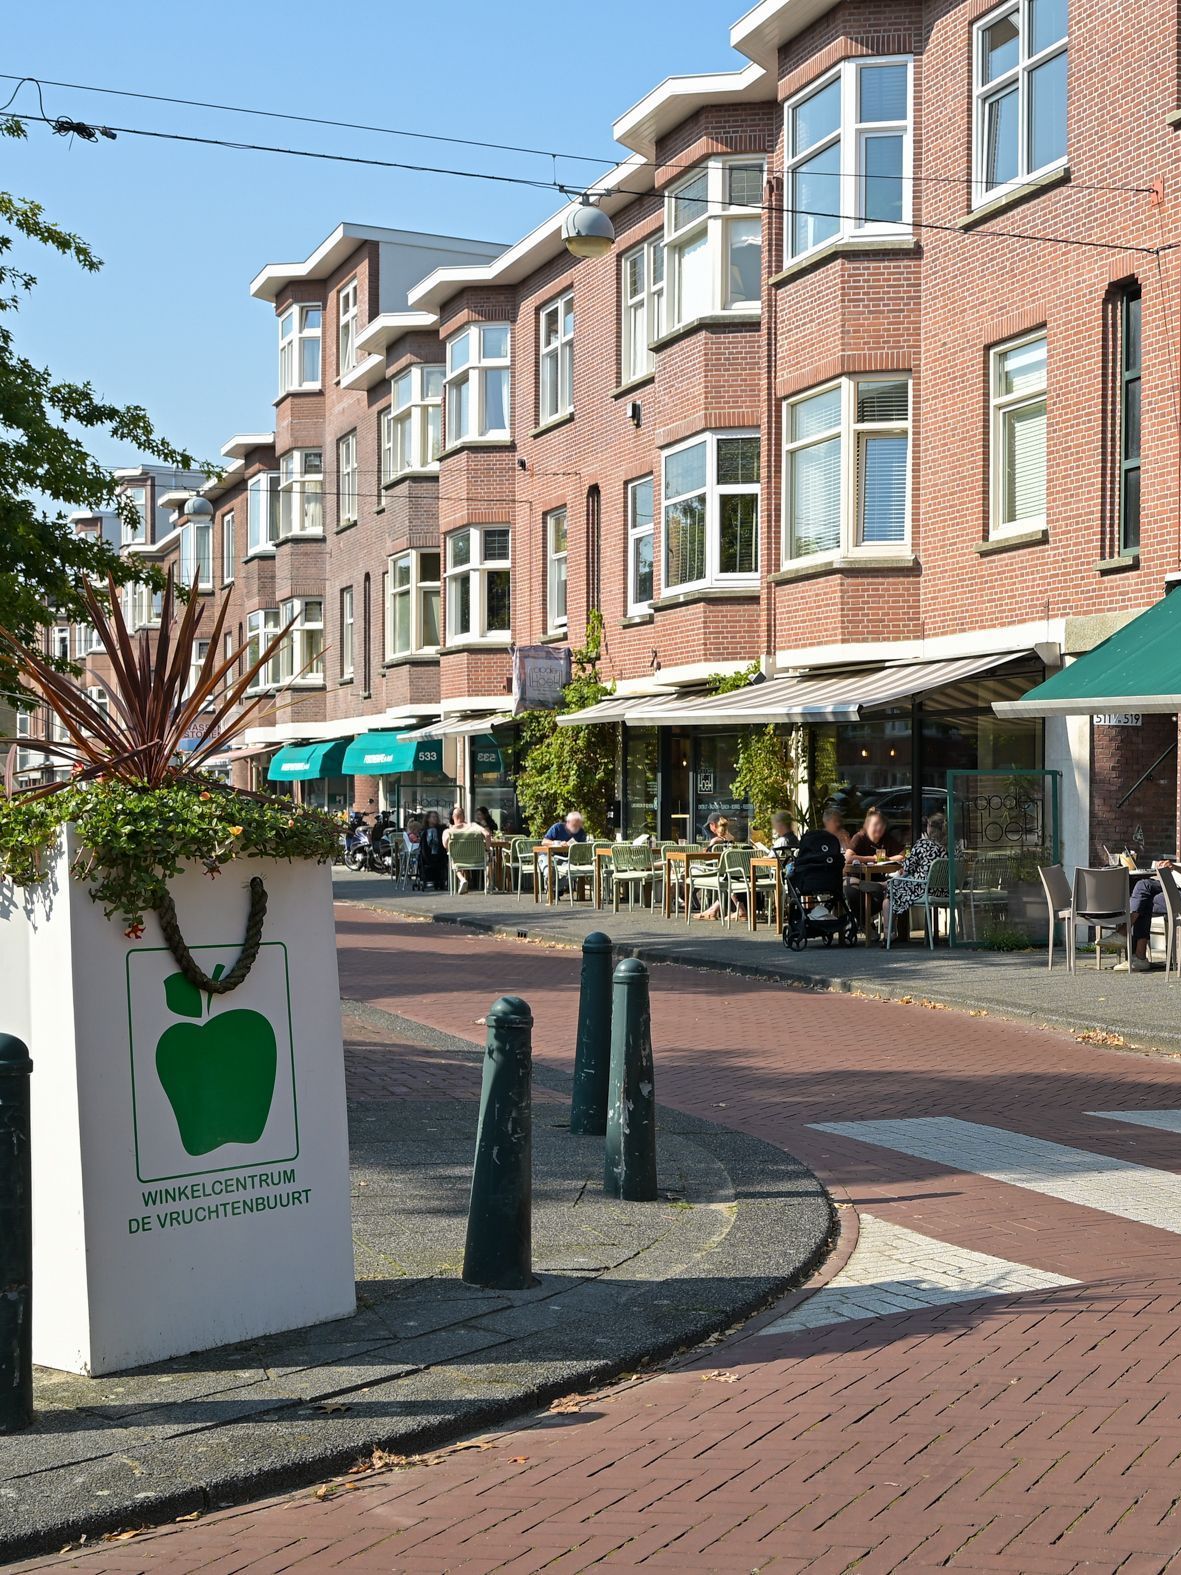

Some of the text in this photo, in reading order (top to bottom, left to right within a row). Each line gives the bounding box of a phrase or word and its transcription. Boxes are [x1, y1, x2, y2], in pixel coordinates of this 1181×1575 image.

[1123, 714, 1140, 724] 519
[184, 731, 221, 739] STOEN
[418, 751, 437, 761] 533
[142, 1168, 296, 1207] WINKELCENTRUM
[128, 1189, 312, 1234] DE VRUCHTENBUURT
